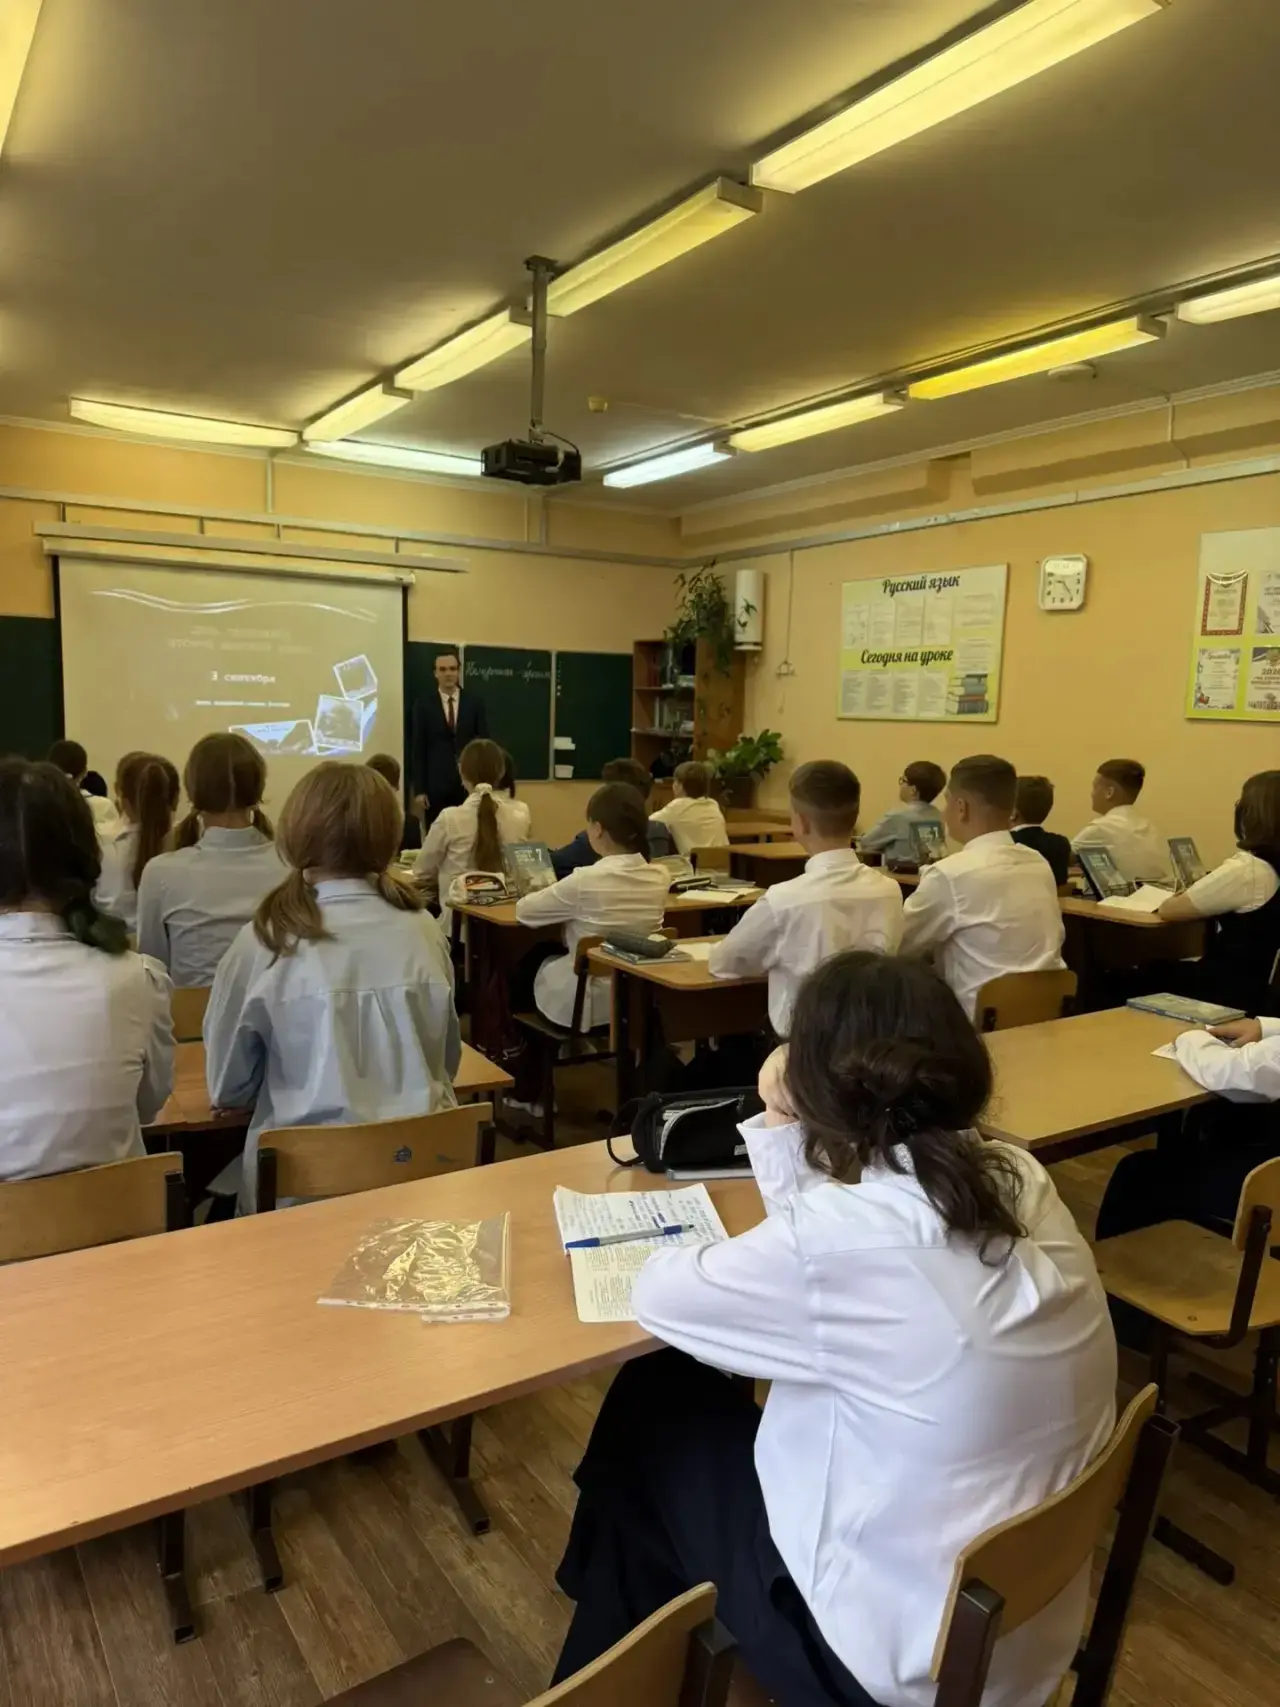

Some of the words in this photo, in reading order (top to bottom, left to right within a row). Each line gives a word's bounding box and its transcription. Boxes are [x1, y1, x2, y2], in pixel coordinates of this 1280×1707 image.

[883, 575, 927, 598] Русский
[928, 575, 960, 594] язык
[861, 648, 902, 668] Сегодня
[904, 651, 919, 662] на
[920, 649, 953, 667] уроке
[535, 848, 542, 862] 7
